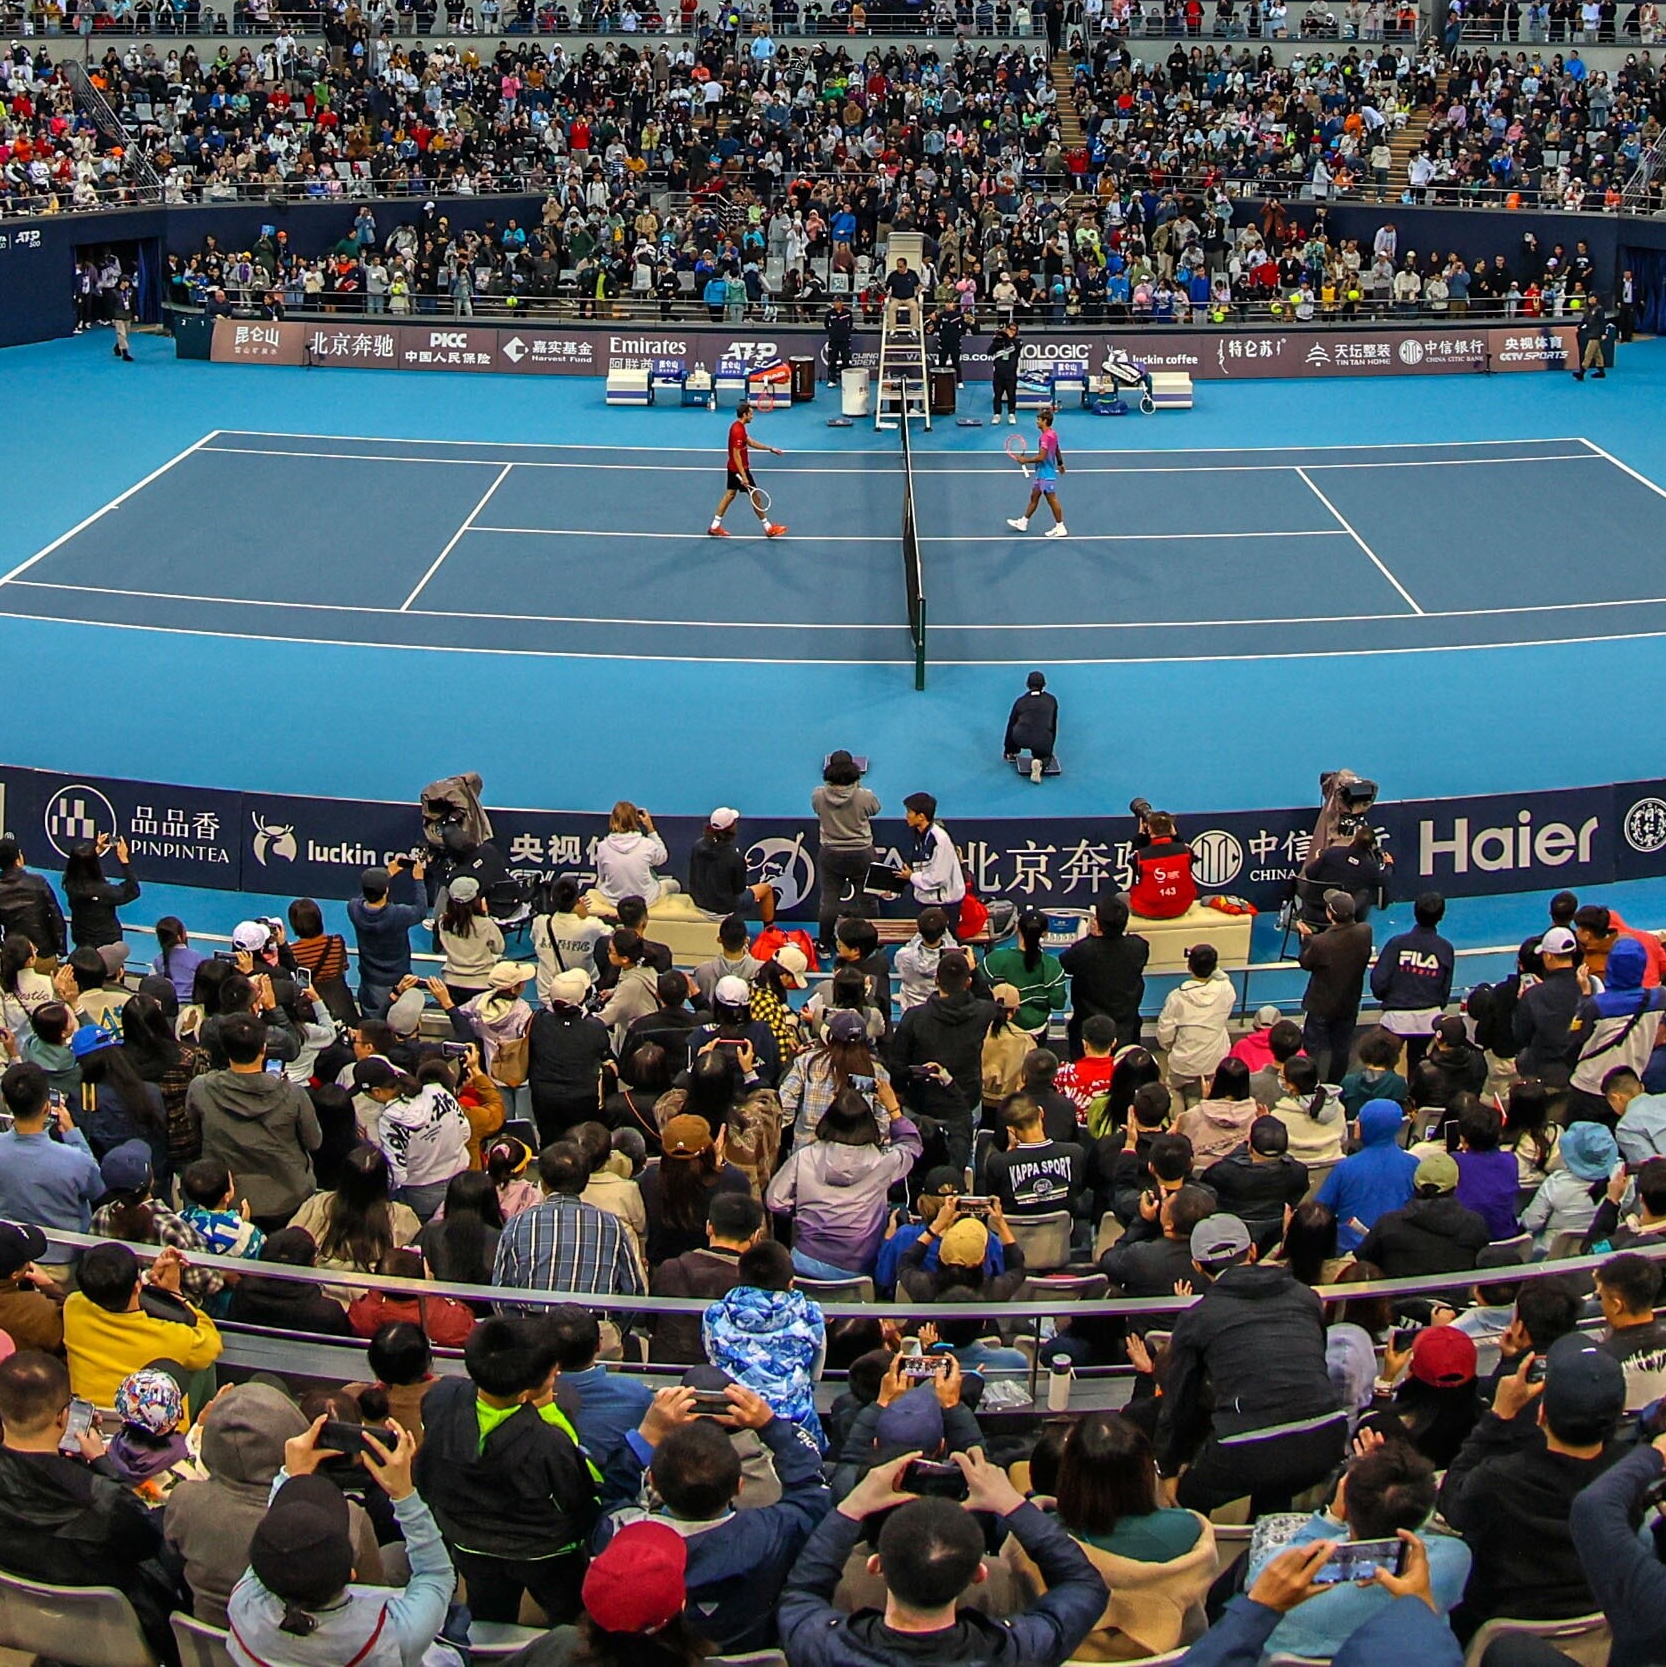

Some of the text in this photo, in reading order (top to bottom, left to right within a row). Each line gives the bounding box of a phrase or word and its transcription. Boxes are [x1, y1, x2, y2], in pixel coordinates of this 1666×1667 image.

[15, 230, 41, 244] ATP
[234, 327, 281, 347] 昆仑山
[310, 330, 395, 358] 北京奔驰
[429, 332, 468, 349] PICC
[1504, 337, 1563, 351] 央视体育
[532, 340, 593, 356] 嘉实基金
[610, 337, 687, 356] Emirates
[719, 342, 778, 361] ATP
[1229, 339, 1273, 360] 特仑苏
[1335, 343, 1391, 360] 天坛整装
[1424, 340, 1485, 356] 中信银行
[405, 350, 491, 367] 中国人民保险
[531, 356, 593, 364] Harvest Fund
[1133, 354, 1198, 365] luckin coffee
[1425, 356, 1485, 365] CHINA CITIC BANK
[1524, 351, 1570, 361] SPORTS
[130, 805, 221, 841] 品品香
[1419, 809, 1598, 876] Haier
[131, 838, 230, 865] PINPINTEA
[308, 840, 376, 867] luckin
[1249, 867, 1296, 882] CHINA
[1399, 950, 1439, 970] FILA
[1009, 1156, 1072, 1193] KAPPA SPORT
